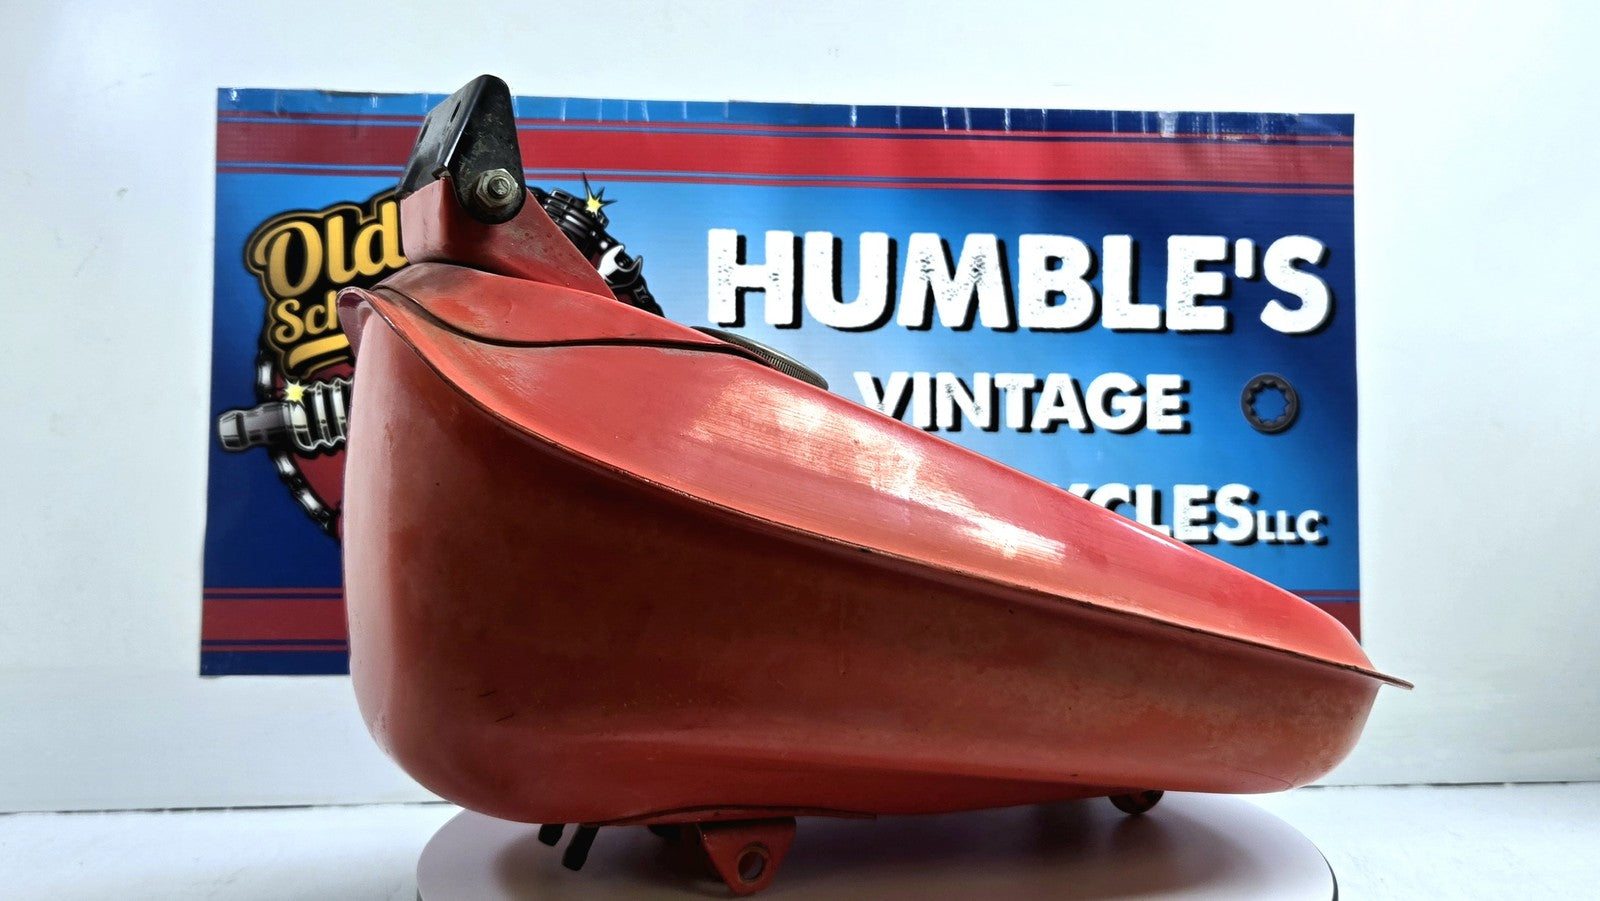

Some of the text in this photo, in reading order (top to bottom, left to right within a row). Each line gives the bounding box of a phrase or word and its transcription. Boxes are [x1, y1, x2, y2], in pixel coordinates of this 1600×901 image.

[254, 200, 408, 297] Old
[707, 228, 1331, 334] HUMBLE'S
[853, 371, 1183, 431] VINTAGE
[1064, 482, 1321, 542] CLES LLC
